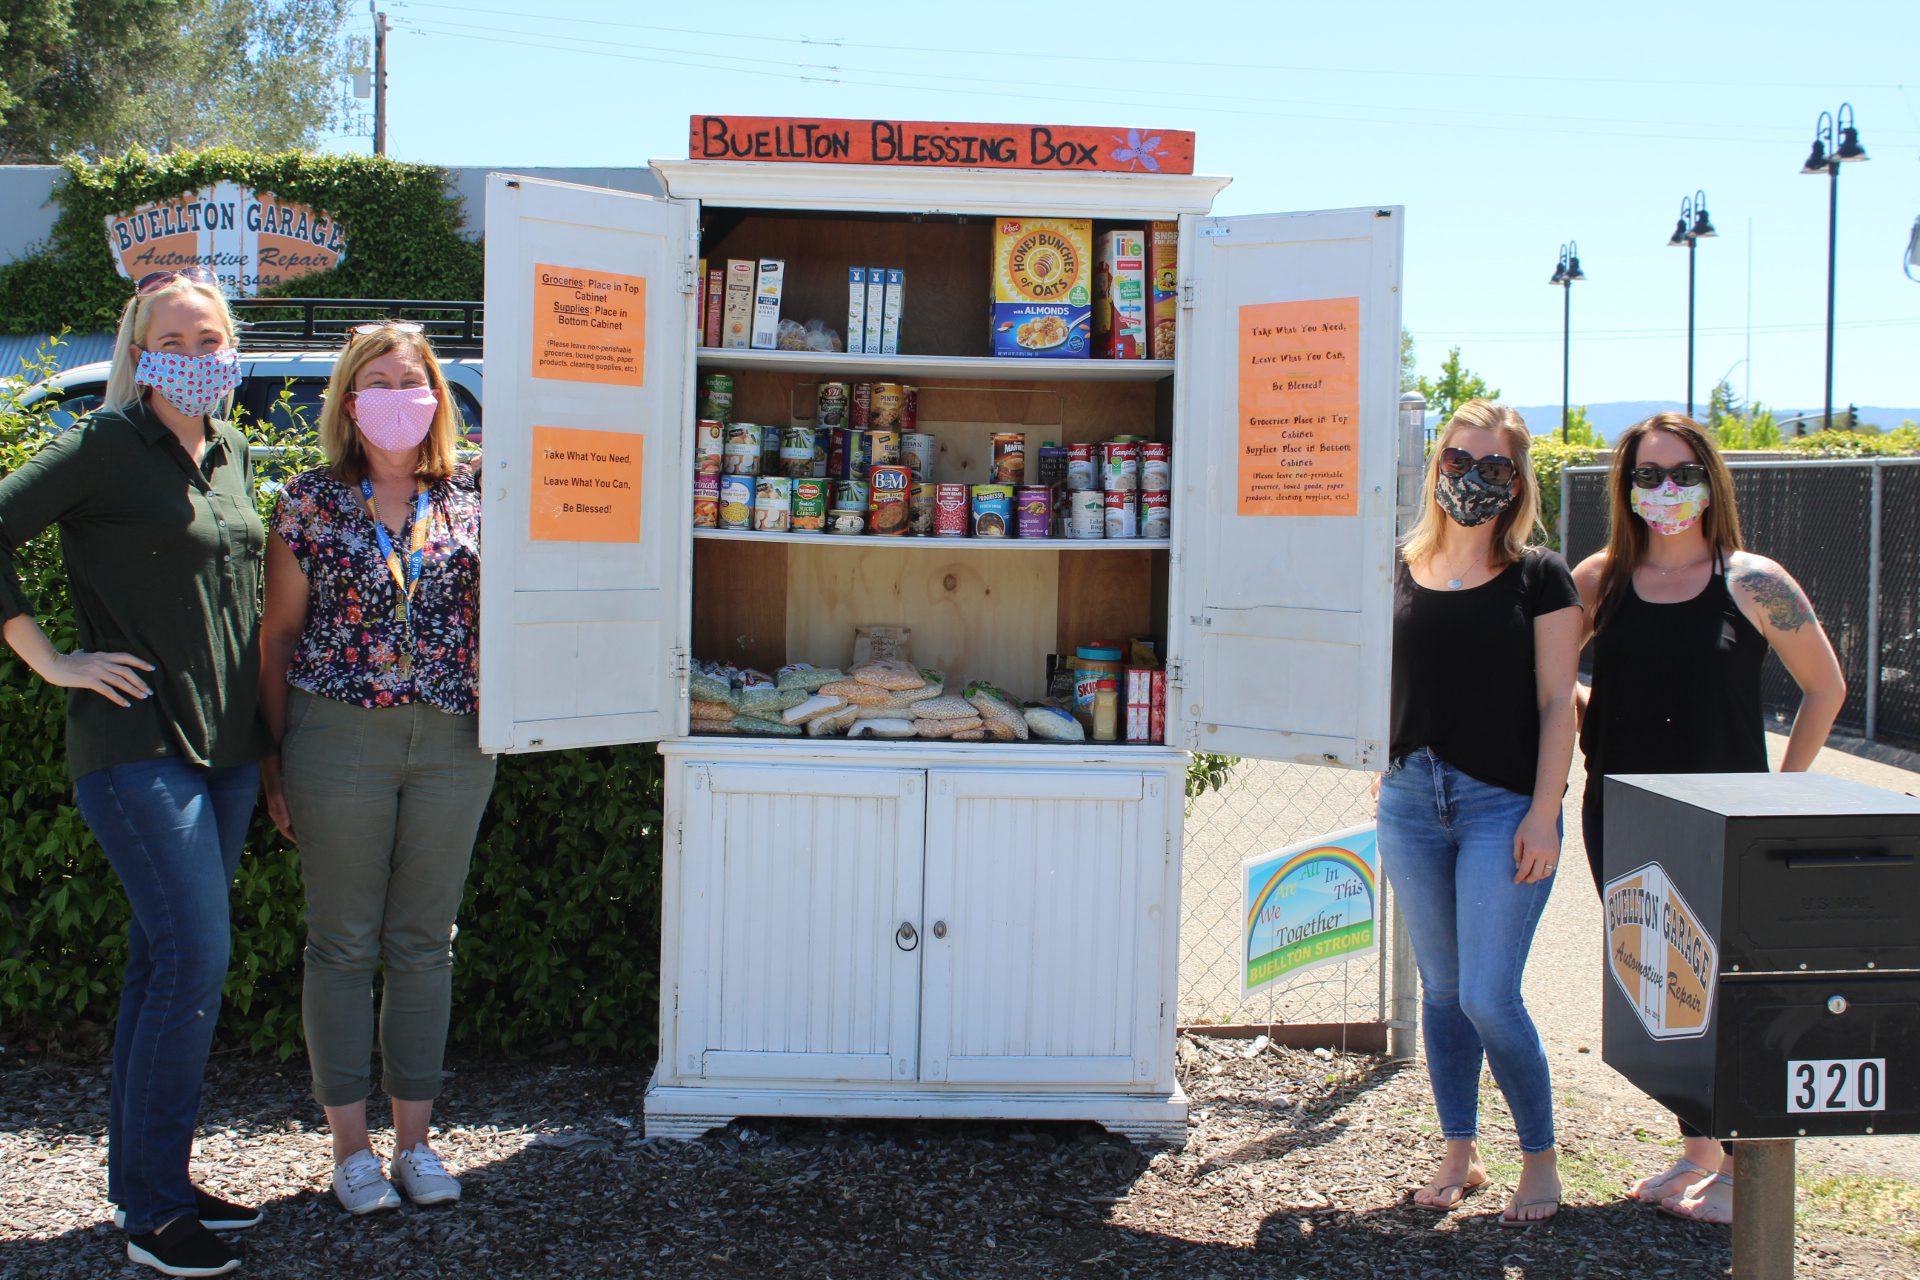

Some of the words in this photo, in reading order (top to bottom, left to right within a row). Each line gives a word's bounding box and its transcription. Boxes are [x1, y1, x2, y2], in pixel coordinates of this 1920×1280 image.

[702, 116, 849, 159] BUELLTON
[871, 120, 1017, 163] BLESSING
[1030, 126, 1099, 165] BOX
[114, 202, 235, 252] BUELLTON
[246, 203, 344, 254] GARAGE
[1003, 223, 1020, 235] Post
[132, 247, 249, 266] Automotive
[258, 248, 329, 268] Repair
[1014, 236, 1037, 272] HONEY
[1038, 233, 1074, 274] BUNCHES
[542, 273, 586, 288] Groceries:
[588, 279, 611, 291] Place
[613, 282, 622, 291] in
[623, 283, 639, 296] Top
[1020, 277, 1033, 288] of
[1032, 279, 1068, 296] OATS
[575, 290, 607, 303] Cabinet
[553, 301, 593, 314] Supplies:
[595, 306, 617, 317] Place
[619, 309, 628, 318] in
[1024, 306, 1070, 315] ALMONDS
[558, 315, 588, 327] Bottom
[590, 318, 623, 330] Cabinet
[1251, 327, 1272, 337] Take
[1276, 326, 1297, 334] What
[1301, 324, 1317, 333] You
[587, 344, 632, 354] non-perishable
[575, 352, 594, 360] boxed
[617, 355, 635, 363] paper
[1251, 356, 1276, 364] Leave
[1280, 354, 1302, 363] What
[1305, 352, 1322, 361] You
[1326, 351, 1345, 361] Can,
[570, 361, 595, 370] cleaning
[1272, 381, 1283, 391] Be
[1288, 379, 1322, 390] Blessed!
[1294, 415, 1313, 424] Place
[1317, 415, 1326, 424] in
[1332, 414, 1348, 424] Top
[1281, 430, 1314, 439] Cabinet
[1282, 443, 1302, 453] Place
[1319, 442, 1351, 453] Bottom
[543, 449, 565, 460] Take
[567, 451, 588, 461] What
[590, 452, 606, 462] You
[608, 453, 631, 464] Need,
[1280, 458, 1314, 467] Cabinet
[543, 476, 569, 486] Leave
[571, 477, 592, 487] What
[595, 478, 610, 488] You
[612, 479, 631, 490] Can,
[563, 503, 574, 512] Be
[576, 503, 612, 514] Blessed!
[1259, 905, 1281, 925] We
[1274, 881, 1297, 901] Are
[1300, 859, 1320, 880] All
[1323, 866, 1339, 884] In
[1333, 879, 1364, 901] This
[1276, 910, 1343, 950] Together
[1608, 888, 1658, 932] BUELLTON
[1663, 902, 1710, 990] GARAGE
[1250, 945, 1313, 982] BUELLTON
[1315, 929, 1371, 956] STRONG
[1614, 941, 1664, 988] Automotive
[1667, 971, 1702, 1013] Repair
[1795, 1062, 1880, 1110] 320
